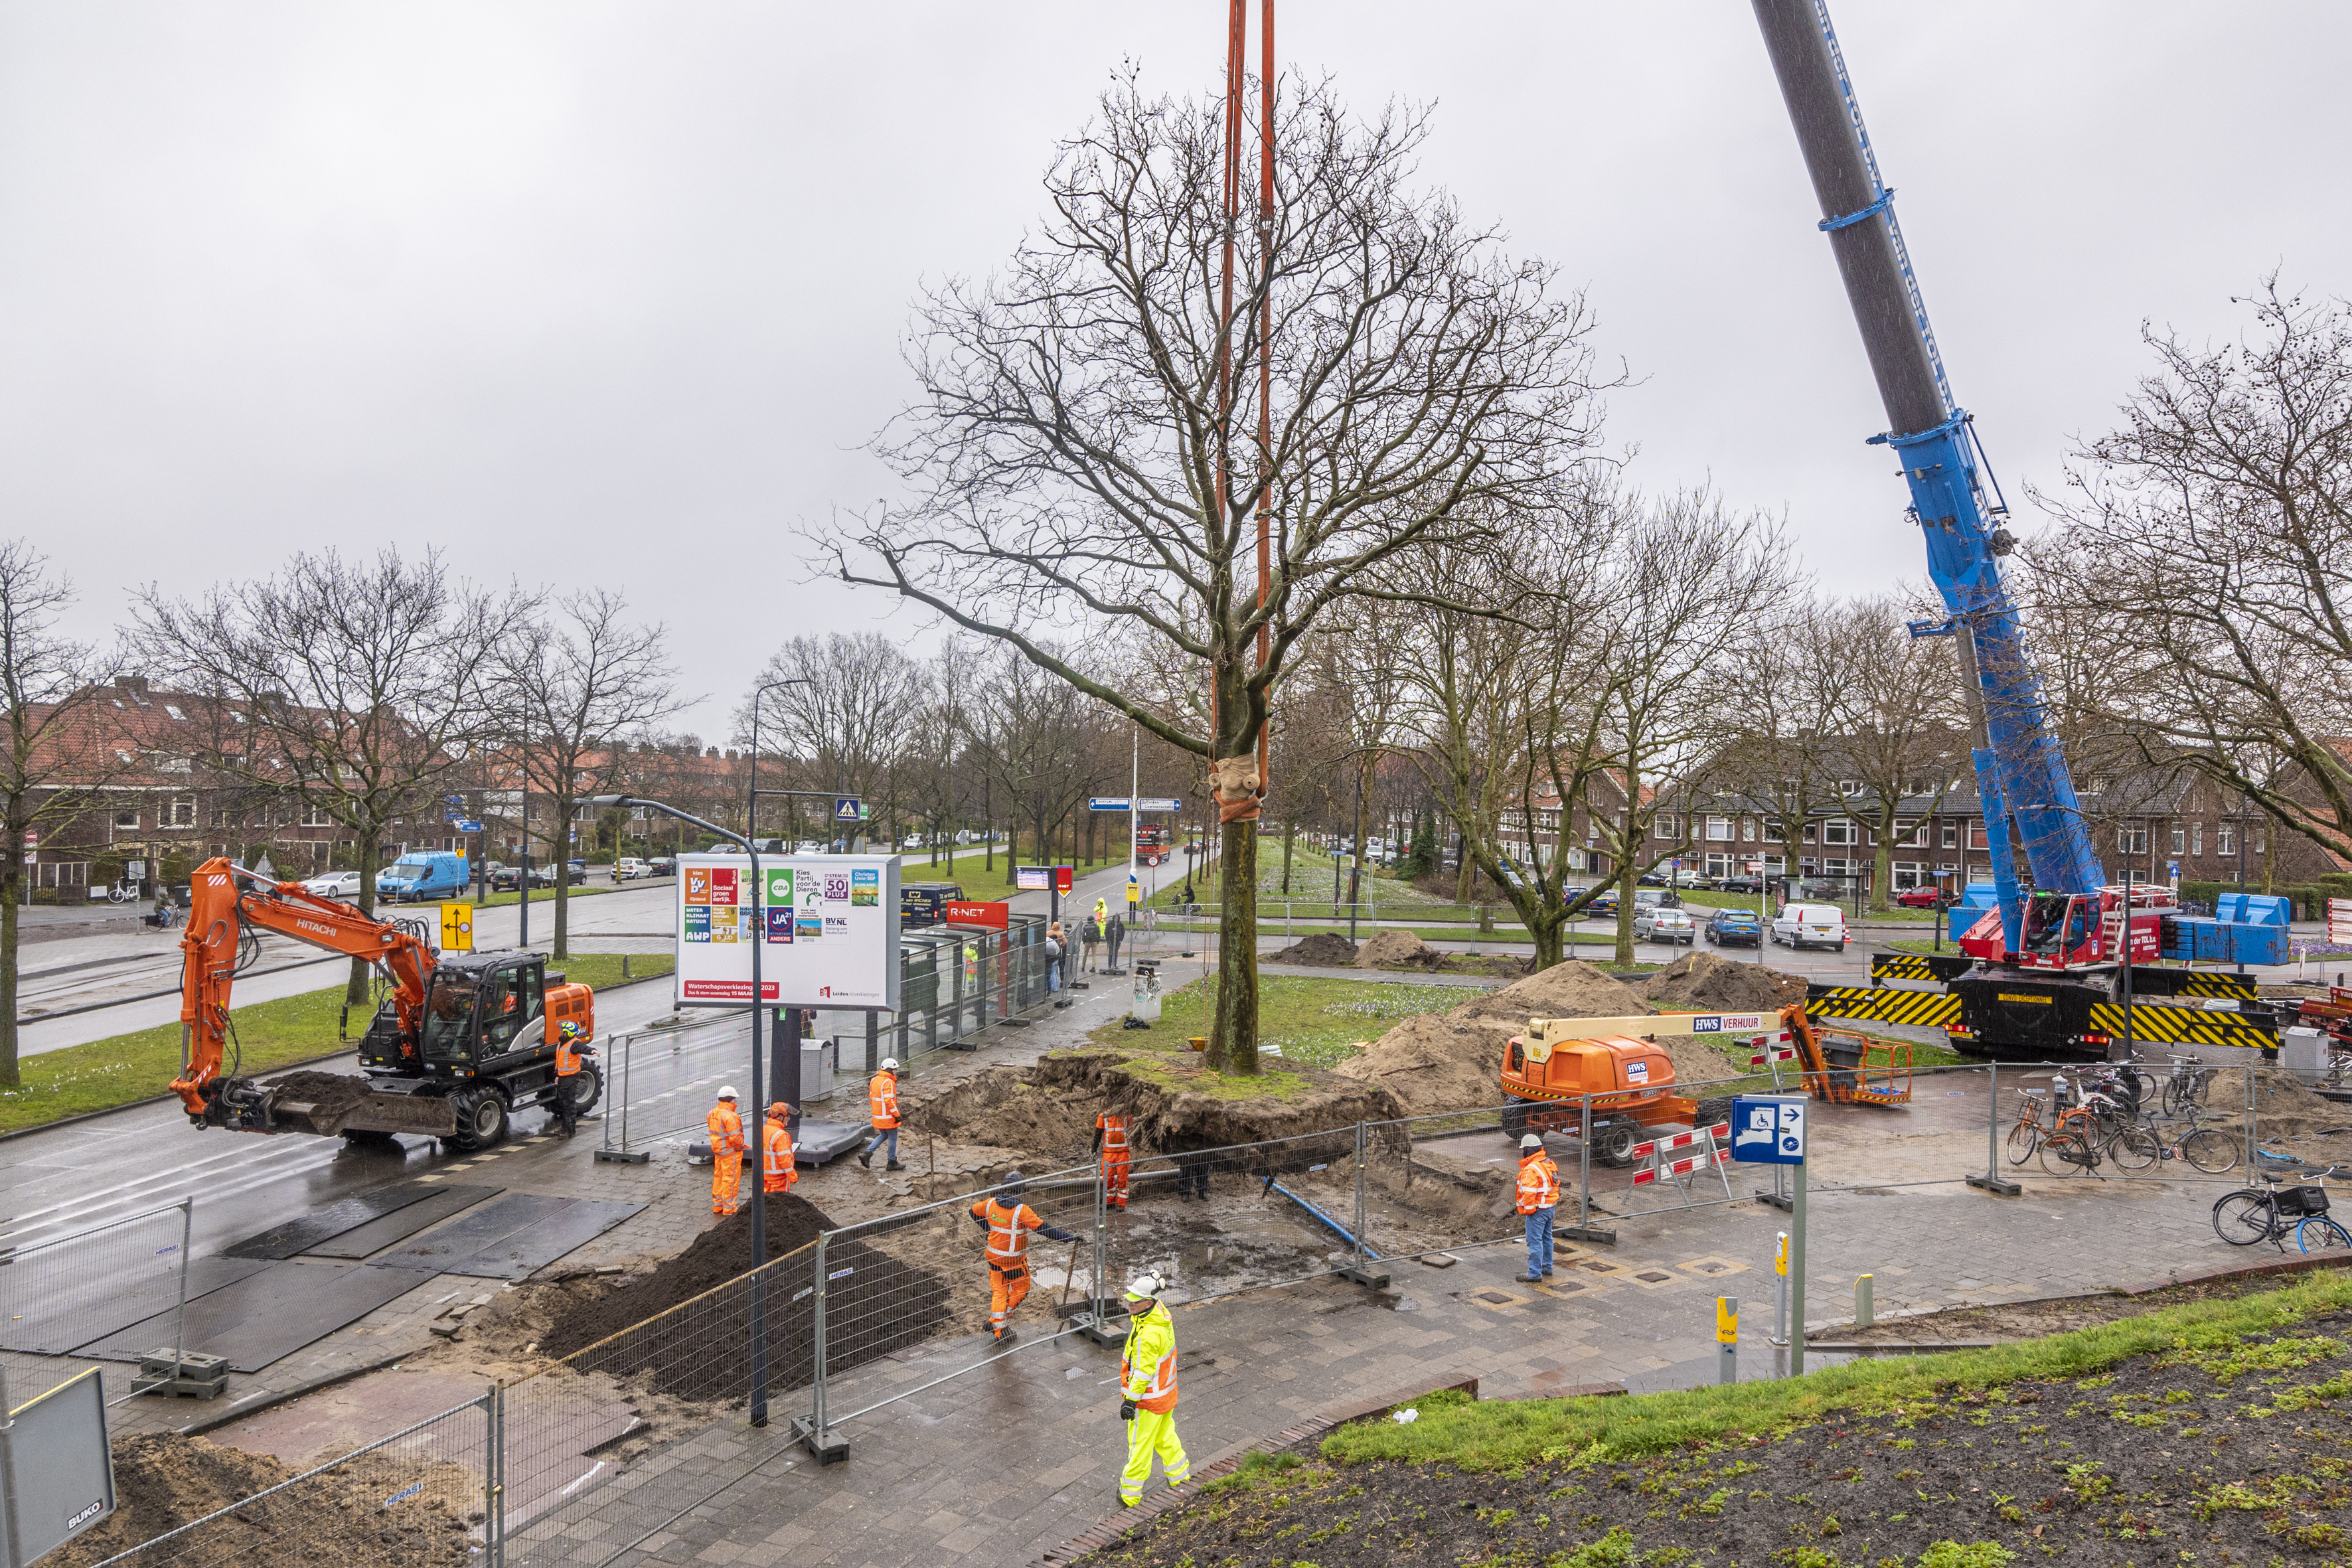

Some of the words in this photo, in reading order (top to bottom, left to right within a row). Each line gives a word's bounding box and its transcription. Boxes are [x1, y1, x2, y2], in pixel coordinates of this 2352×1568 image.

[1815, 0, 1830, 33] an
[1828, 39, 1847, 83] der
[1845, 88, 1865, 143] TOL
[1888, 219, 1908, 271] van
[1905, 274, 1924, 319] der
[1920, 321, 1940, 377] TOL
[827, 880, 845, 891] 50
[296, 918, 337, 937] HITACHI
[686, 931, 710, 941] AWP
[1695, 1018, 1718, 1030] HWS
[1723, 1017, 1759, 1028] VERHUUR
[1628, 1062, 1646, 1073] HWS
